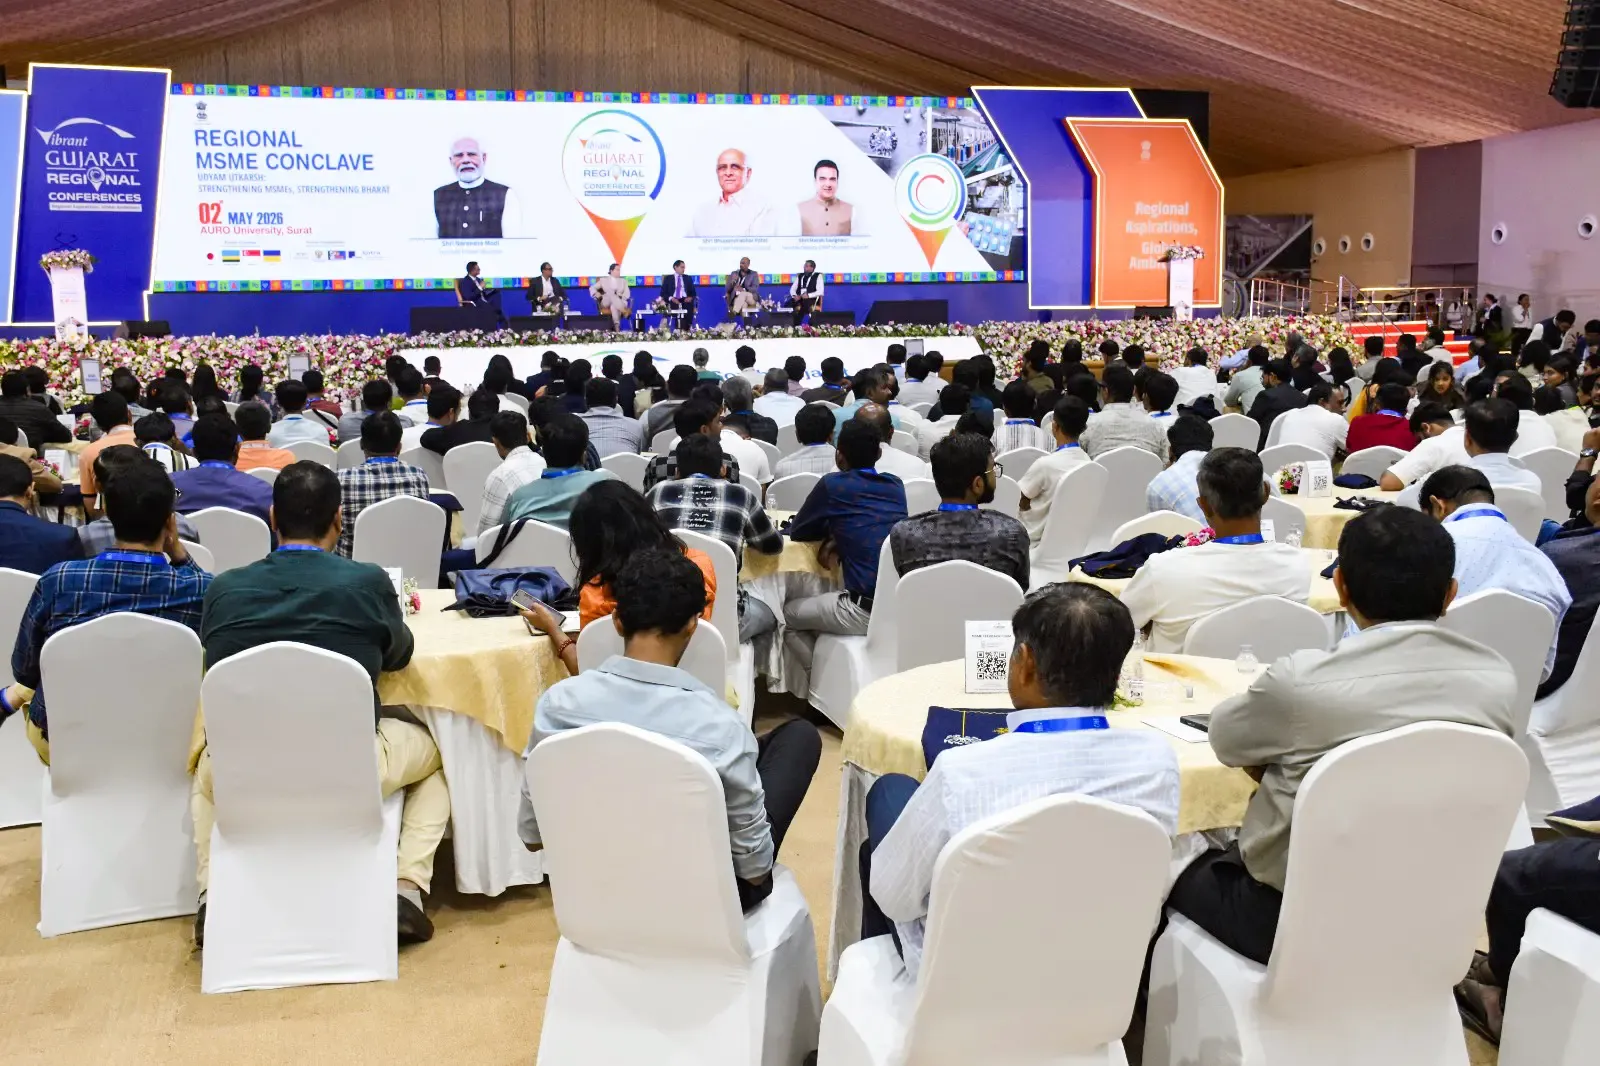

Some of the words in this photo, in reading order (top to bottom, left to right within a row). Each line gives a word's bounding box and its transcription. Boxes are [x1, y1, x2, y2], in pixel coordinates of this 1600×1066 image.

[34, 126, 88, 146] Vibrant
[194, 129, 303, 147] REGIONAL
[45, 150, 138, 167] GUJARAT
[196, 152, 259, 170] MSME
[265, 153, 375, 171] CONCLAVE
[583, 153, 644, 164] GUJARAT
[46, 169, 141, 188] REGIONAL
[197, 173, 227, 181] UDYAM
[229, 173, 267, 182] UTKARSH:
[48, 192, 141, 202] CONFERENCES
[198, 185, 263, 193] STRENGTHENING
[265, 185, 295, 195] MSMEs,
[297, 186, 360, 194] STRENGTHENING
[361, 186, 390, 194] BHARAT
[1135, 202, 1189, 218] Regional
[228, 212, 253, 225] MAY
[257, 212, 284, 225] 2026
[200, 226, 231, 234] AURO
[234, 226, 284, 236] University,
[286, 226, 313, 235] Surat
[1126, 220, 1198, 235] Aspirations,
